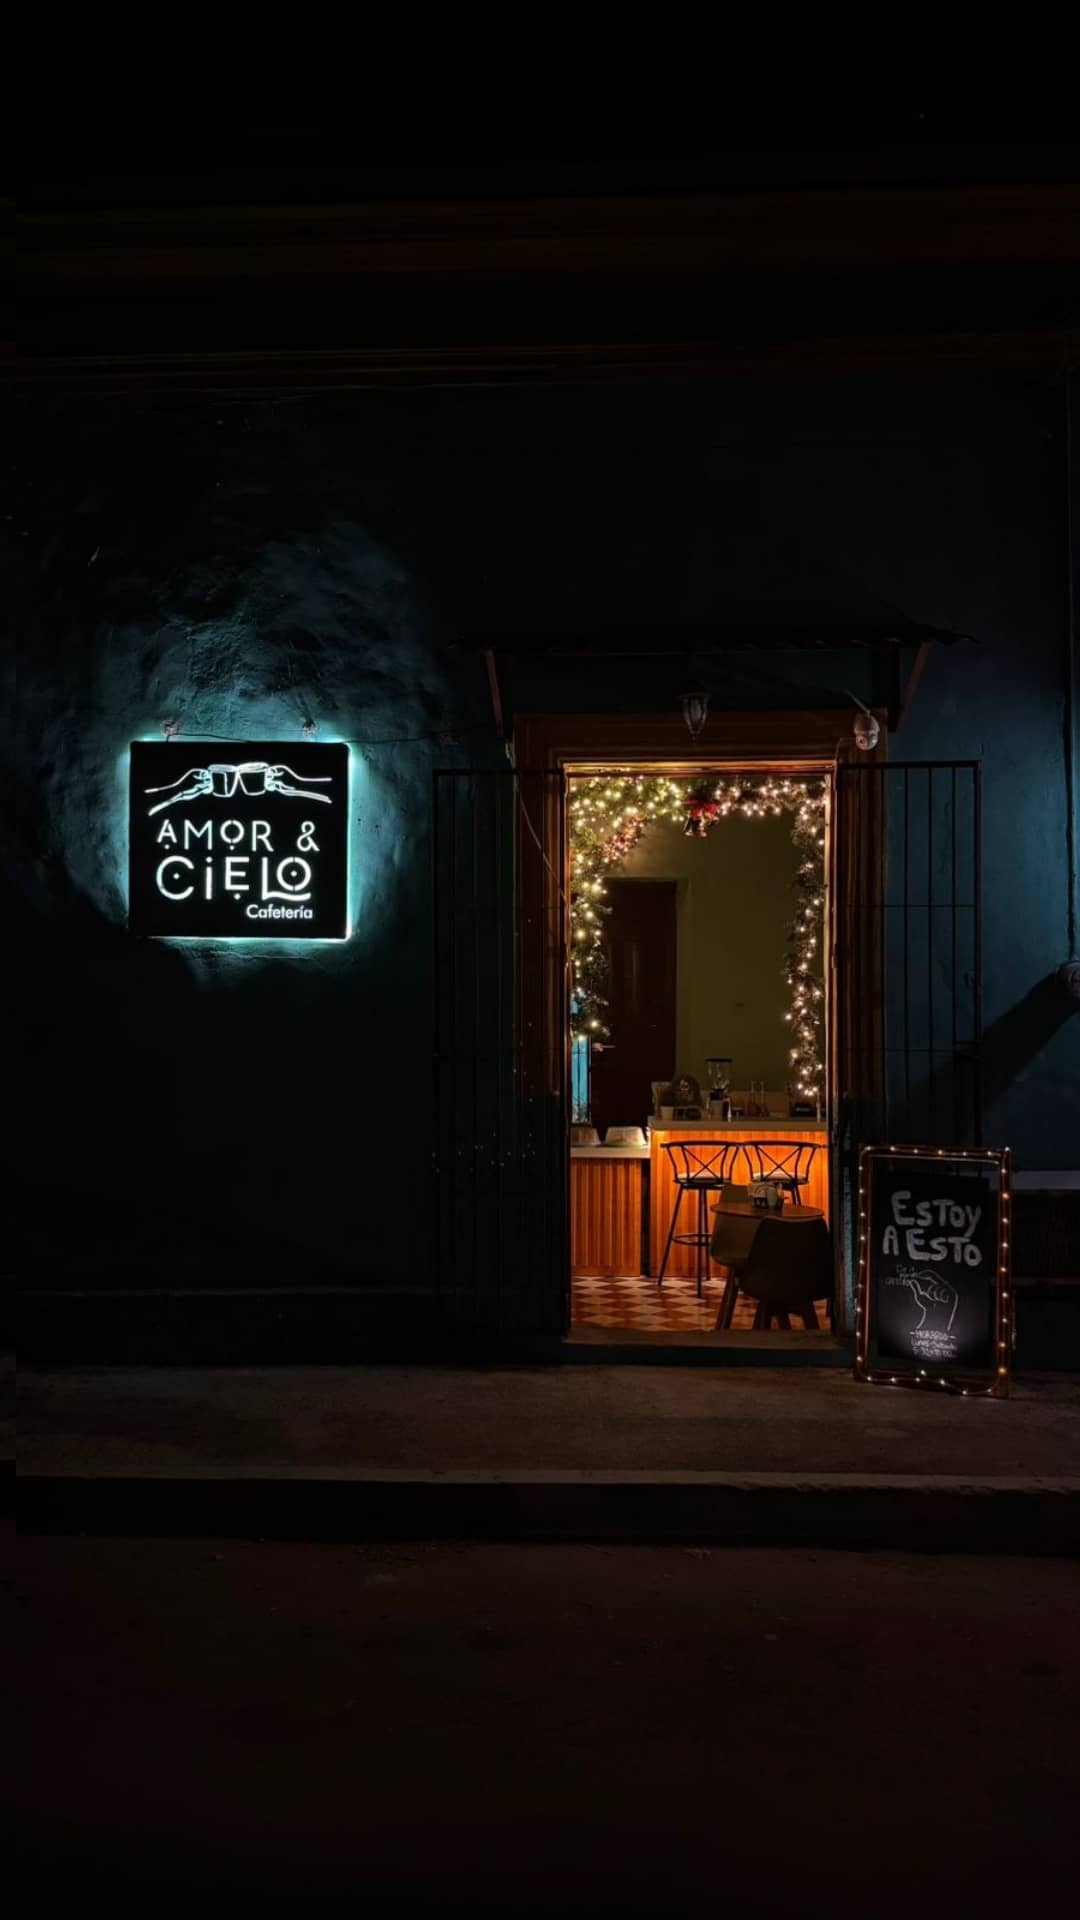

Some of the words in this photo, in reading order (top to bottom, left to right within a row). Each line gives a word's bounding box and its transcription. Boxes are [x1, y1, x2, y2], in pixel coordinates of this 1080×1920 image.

[156, 819, 274, 852] AMOR
[296, 820, 320, 851] &
[246, 903, 313, 919] Cafetería
[882, 1225, 900, 1256] A
[906, 1228, 983, 1267] ESTO
